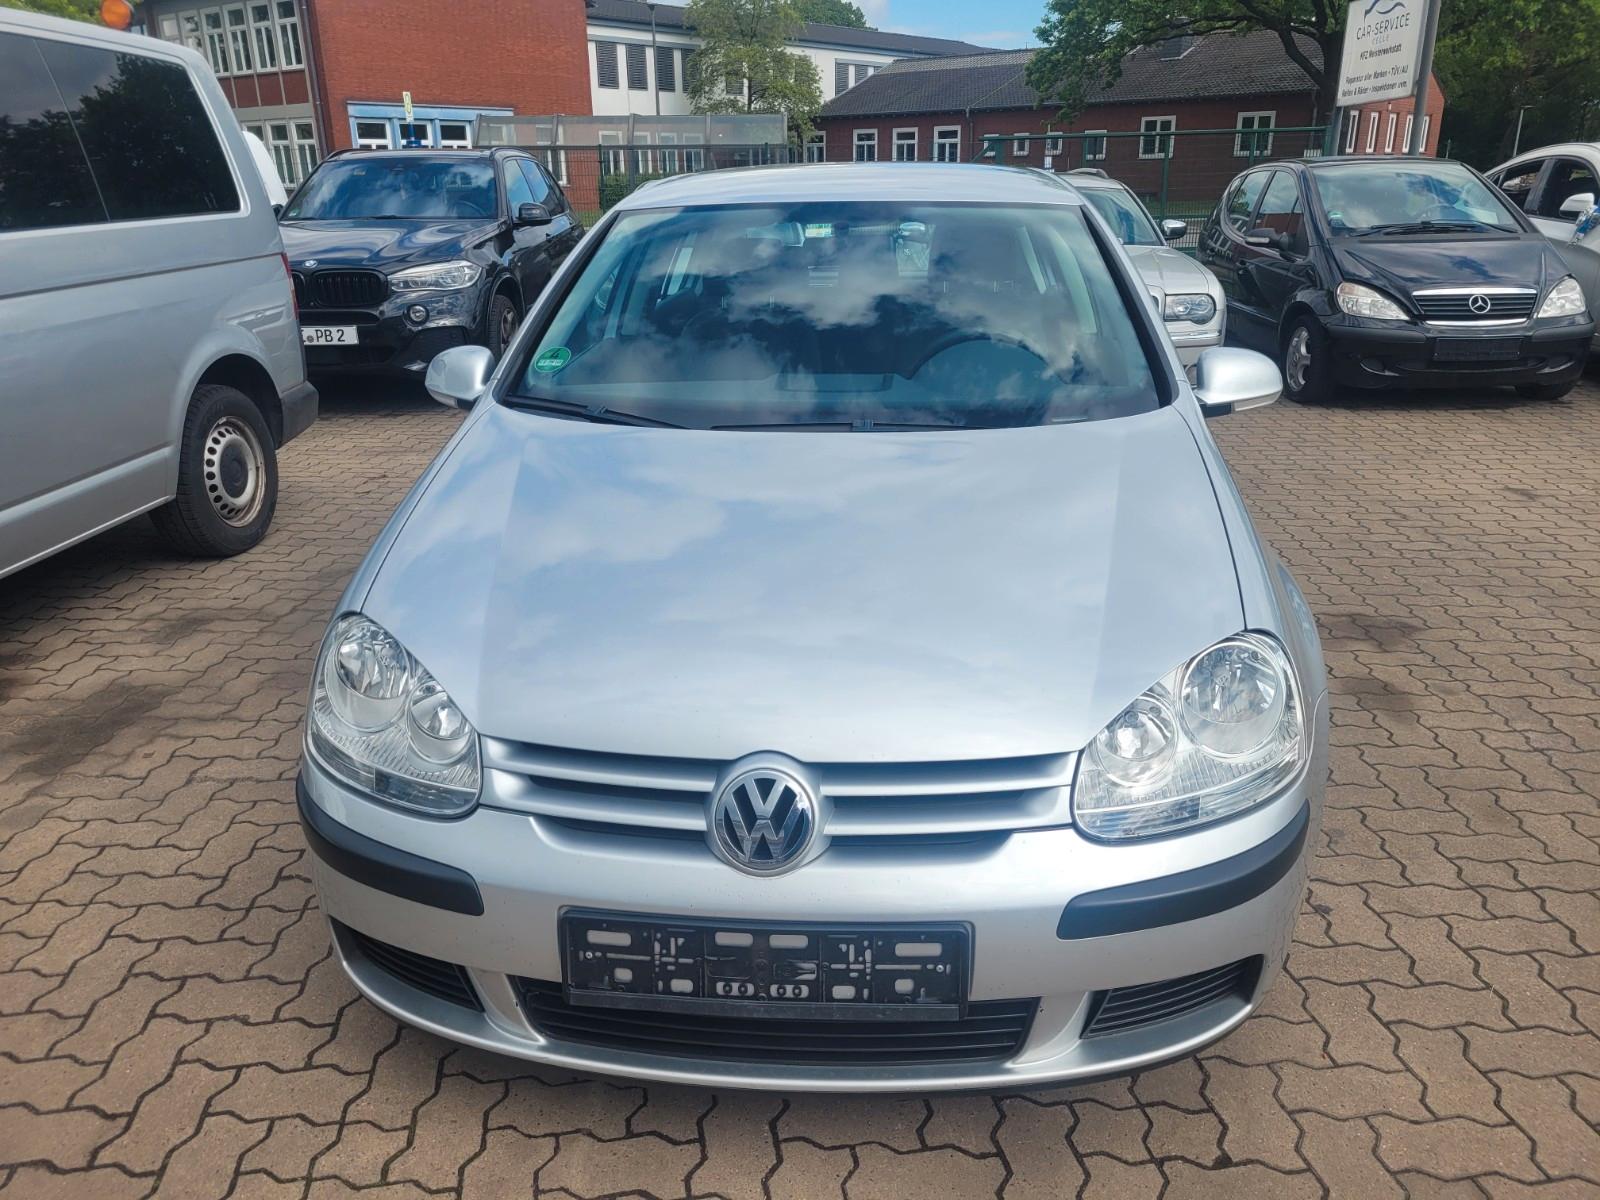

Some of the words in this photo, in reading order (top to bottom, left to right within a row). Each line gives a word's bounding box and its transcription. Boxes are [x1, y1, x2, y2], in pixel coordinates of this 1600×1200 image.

[1356, 13, 1410, 40] CAR-SERVICE
[315, 329, 333, 342] PB
[337, 329, 345, 342] 2
